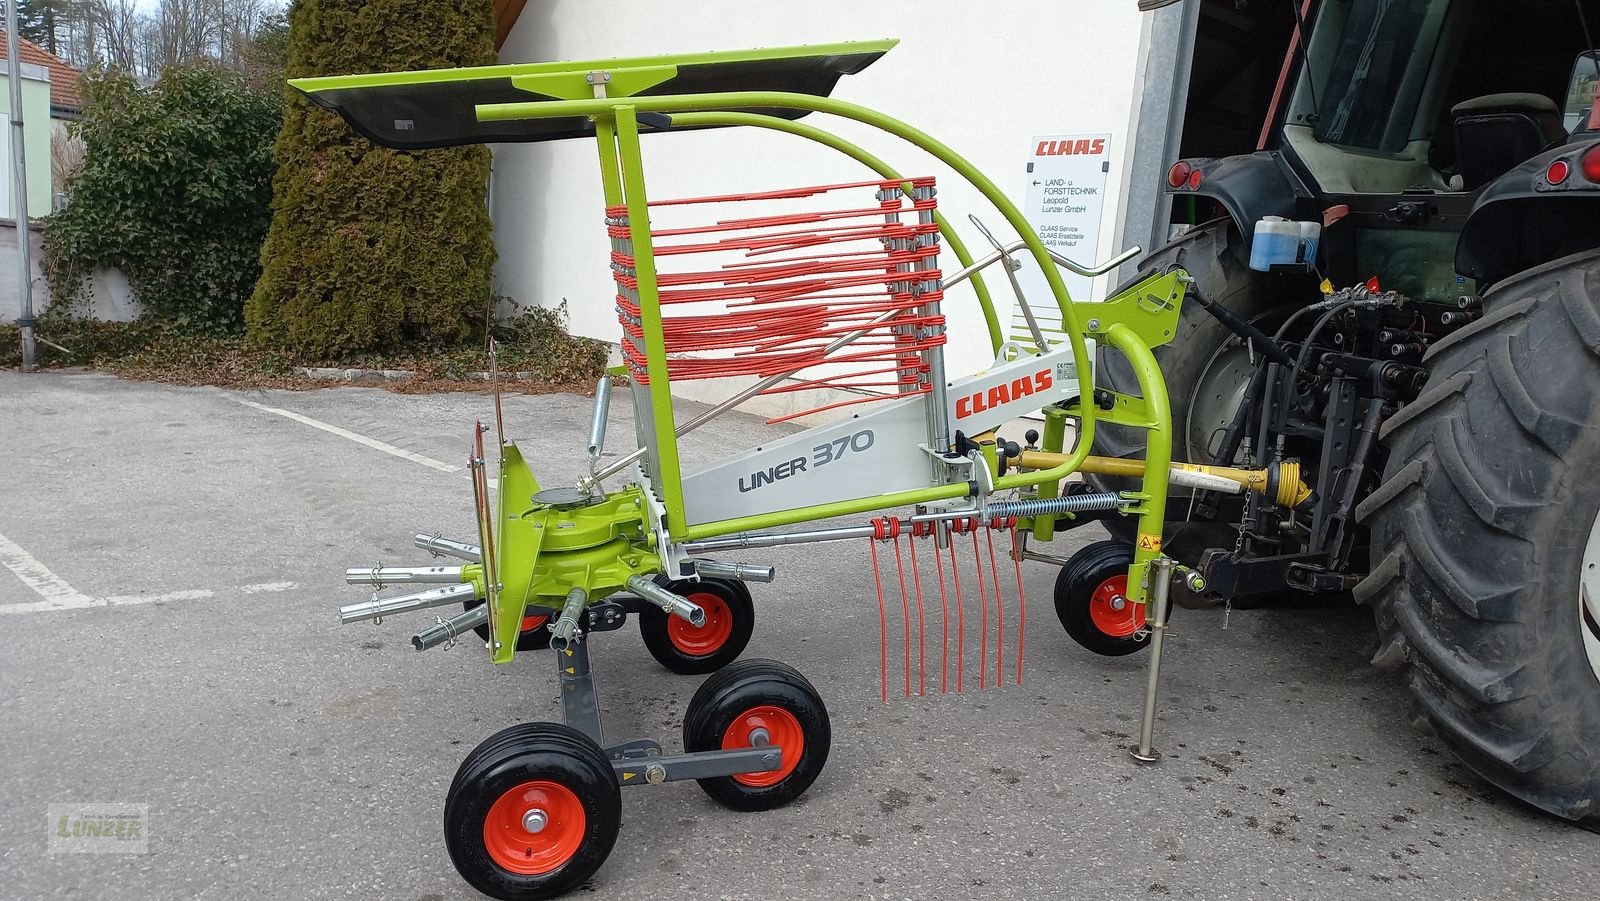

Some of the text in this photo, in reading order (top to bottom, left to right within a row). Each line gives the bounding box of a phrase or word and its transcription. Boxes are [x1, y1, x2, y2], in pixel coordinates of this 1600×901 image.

[1036, 139, 1105, 156] CLAAS
[1045, 179, 1066, 187] LAND-
[1044, 187, 1098, 195] FORSTTECHNIK
[1043, 197, 1068, 205] Leopold
[1042, 205, 1087, 213] Lunzer GmbH
[956, 369, 1052, 419] CLAAS
[738, 429, 875, 493] LINER 370
